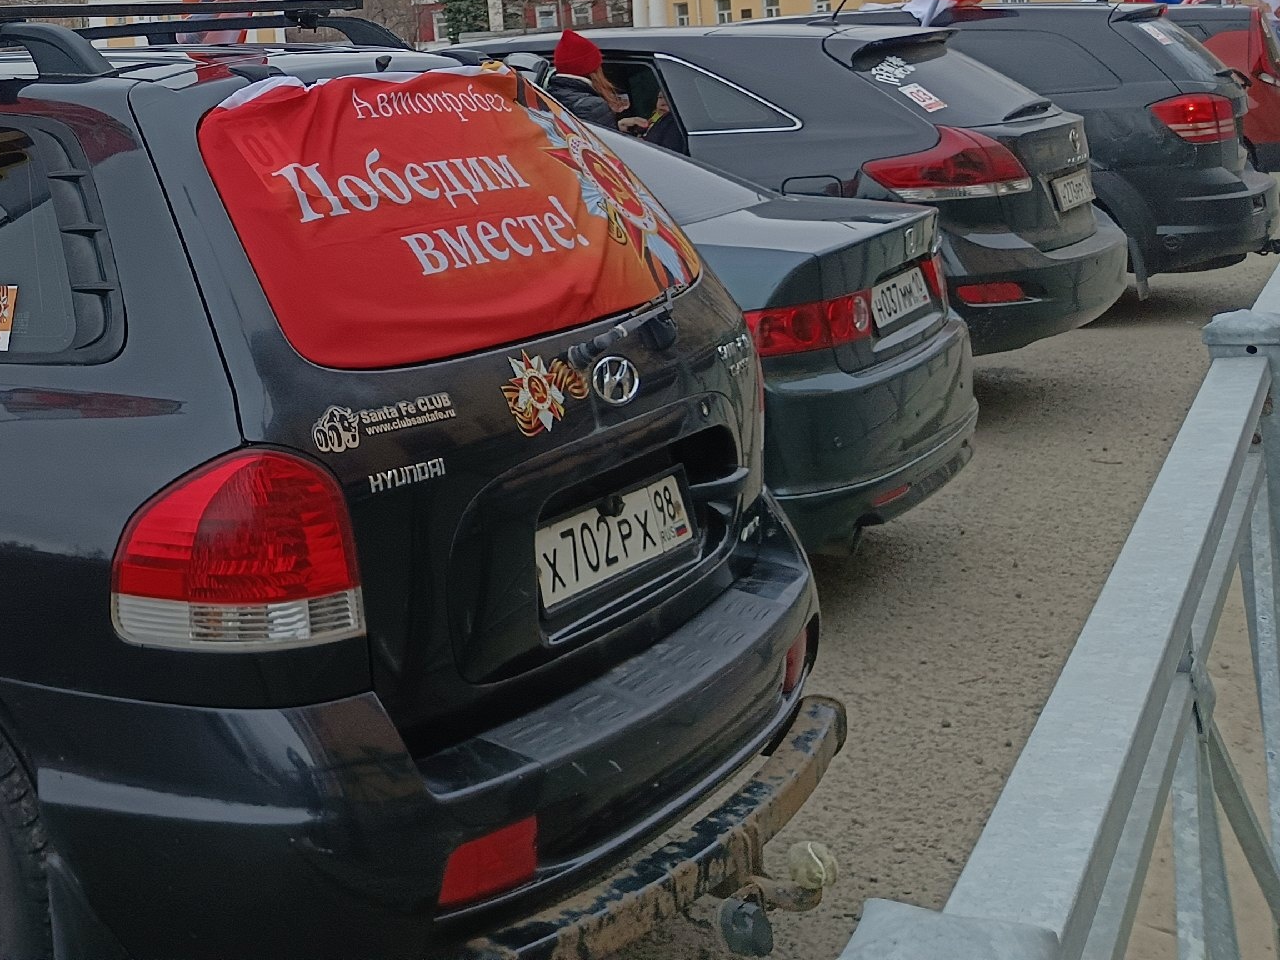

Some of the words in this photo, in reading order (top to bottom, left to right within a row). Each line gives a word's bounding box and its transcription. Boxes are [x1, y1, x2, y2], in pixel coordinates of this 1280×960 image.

[352, 83, 512, 122] Автопробег
[271, 148, 531, 223] Победим
[400, 196, 590, 276] вместе!
[360, 406, 398, 424] Santa
[398, 402, 417, 416] Fe
[417, 393, 452, 412] CLUB
[365, 407, 457, 436] www.clubsantafe.ru
[368, 457, 446, 493] HYUNDAI
[653, 485, 677, 527] 98
